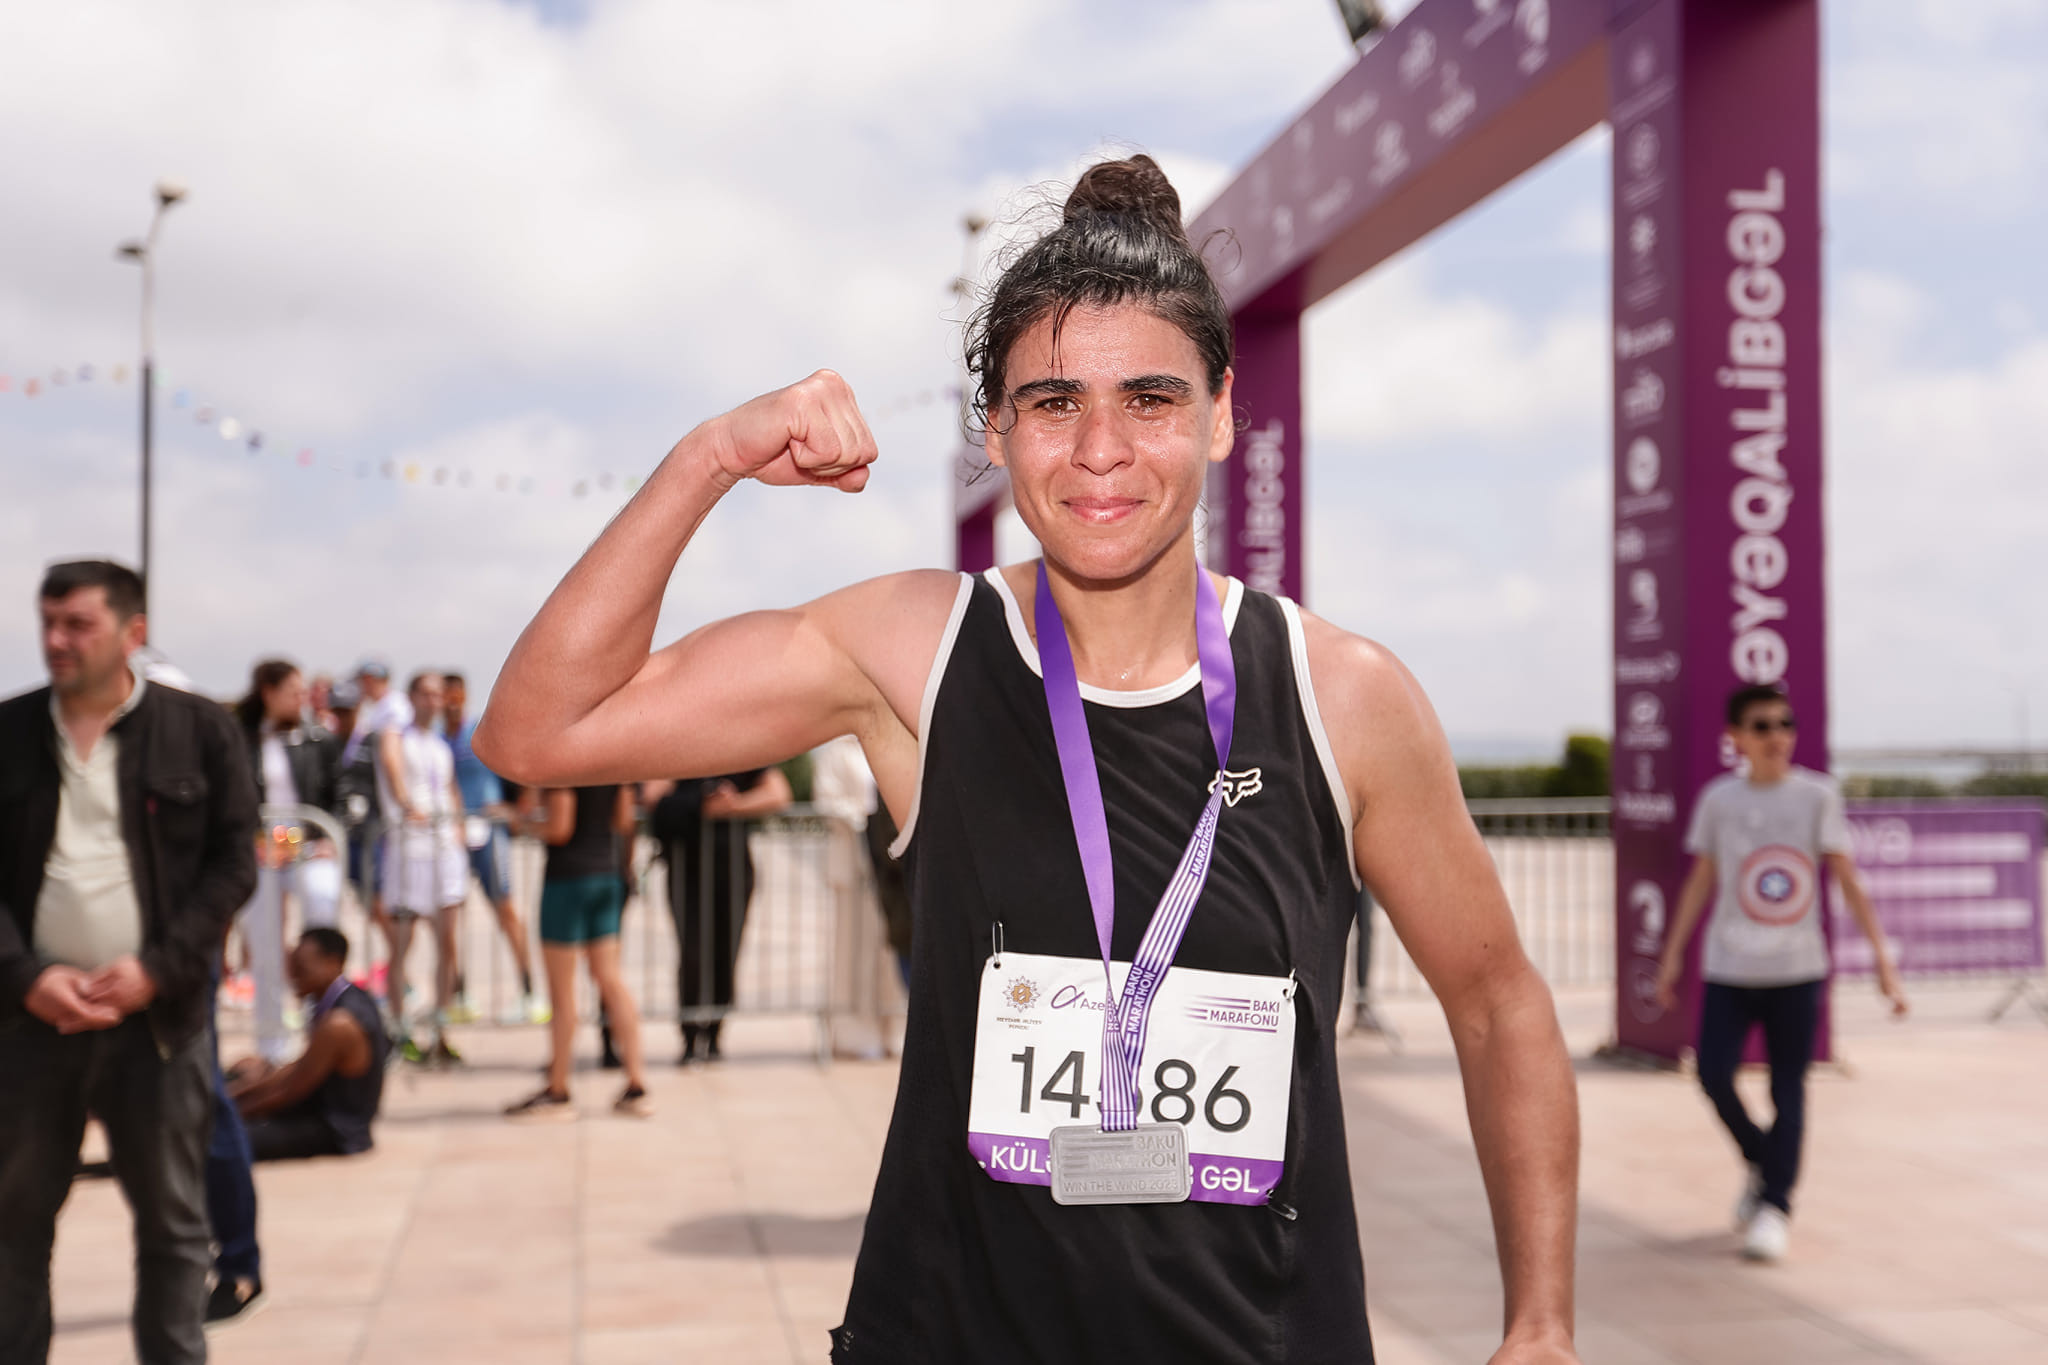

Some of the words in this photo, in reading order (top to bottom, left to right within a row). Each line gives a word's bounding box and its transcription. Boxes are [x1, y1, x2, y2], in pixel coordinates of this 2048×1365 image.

[1195, 807, 1211, 838] BAKU
[1191, 813, 1215, 876] MARATHON
[1123, 965, 1144, 996] BAKU
[1079, 997, 1107, 1012] Aze
[1127, 971, 1157, 1033] MARATHON
[1252, 1000, 1280, 1013] BAKI
[1210, 1009, 1279, 1027] MARAFONU
[1011, 1046, 1251, 1133] 1486
[1137, 1135, 1175, 1150] BAKU
[990, 1141, 1052, 1173] KÜL
[1200, 1165, 1260, 1194] GƏL
[1063, 1182, 1087, 1193] WIN
[1089, 1181, 1113, 1192] THE
[1114, 1180, 1147, 1192] WIND
